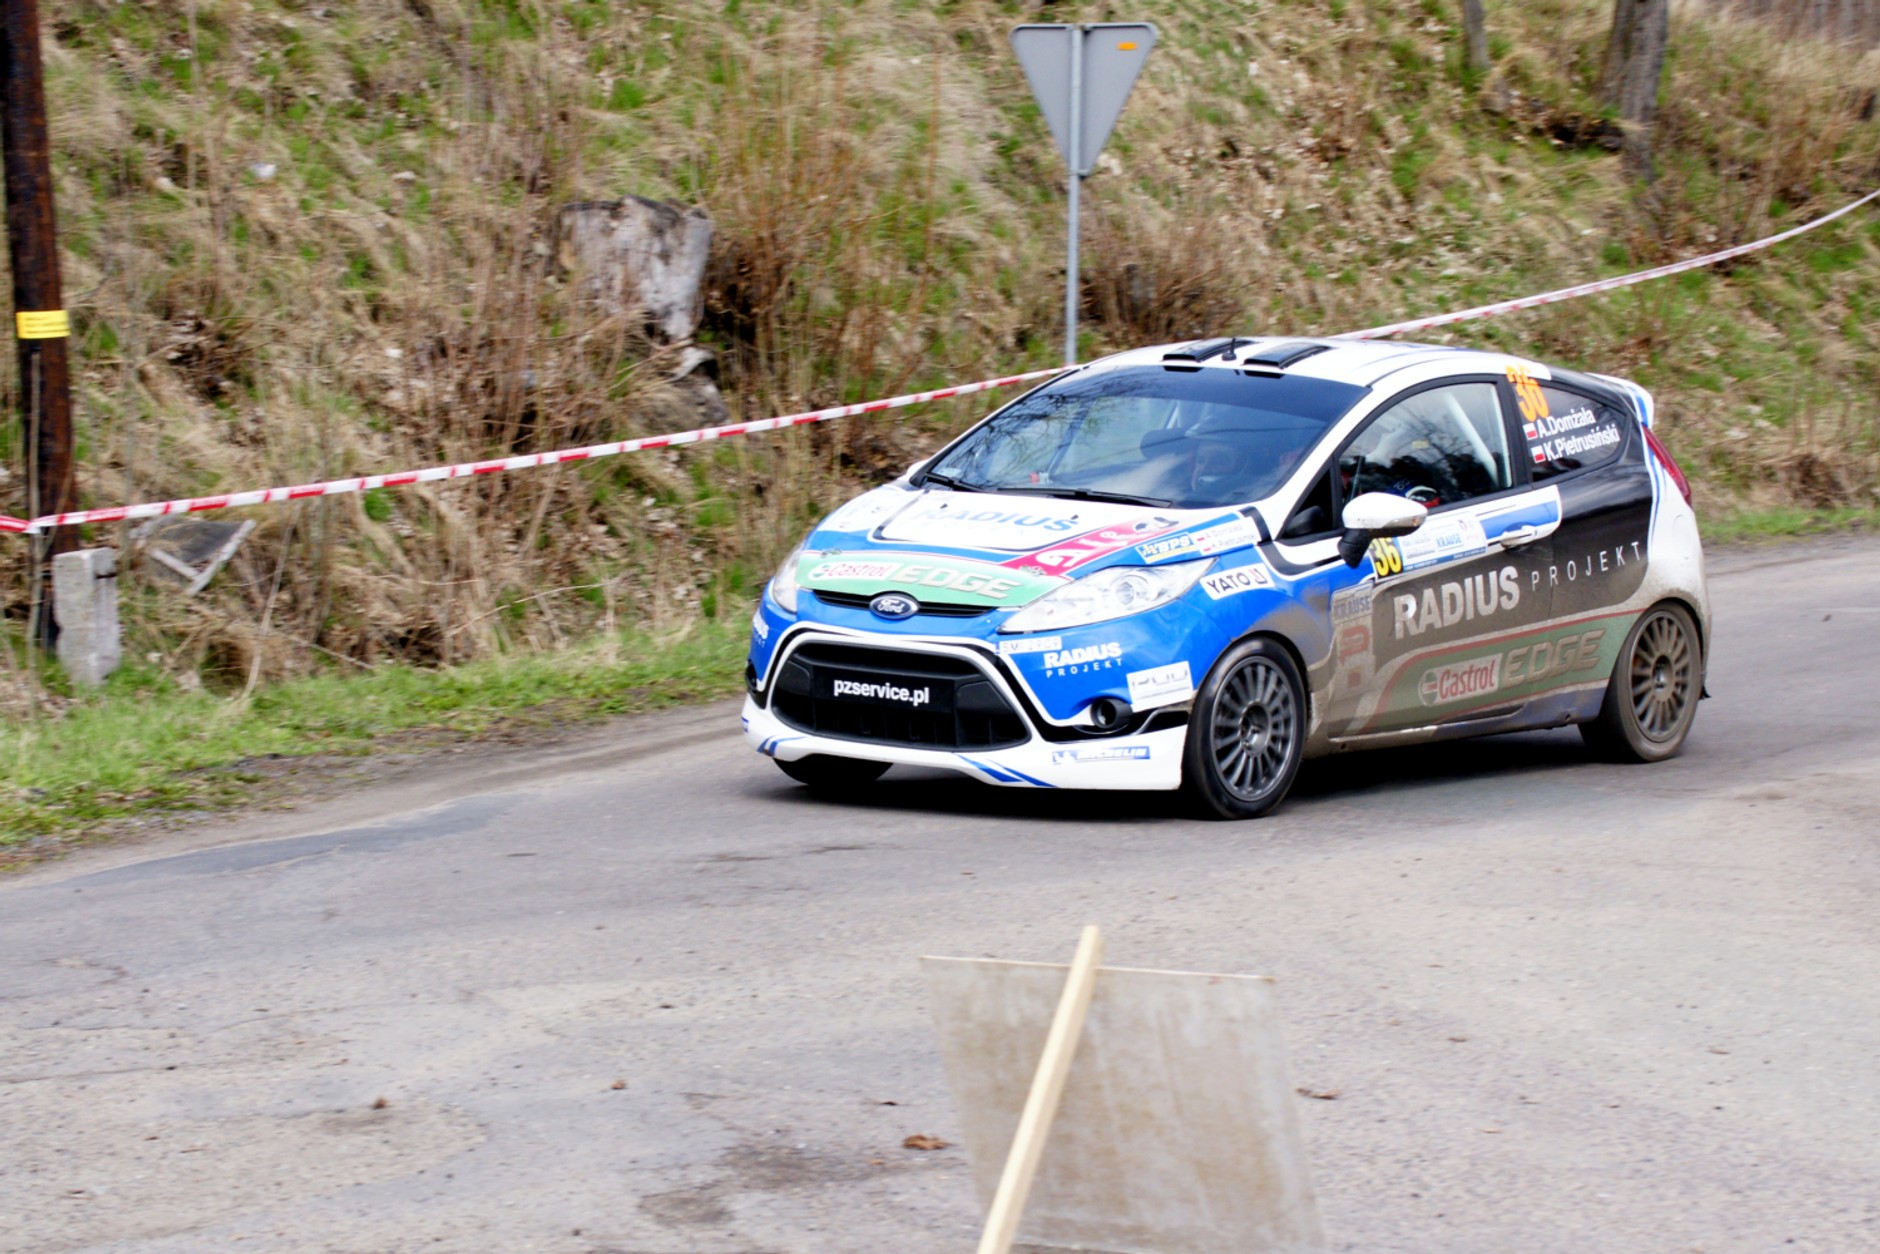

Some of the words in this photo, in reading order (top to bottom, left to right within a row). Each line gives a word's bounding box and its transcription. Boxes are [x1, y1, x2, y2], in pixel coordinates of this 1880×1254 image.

[1505, 364, 1549, 422] 36
[1544, 424, 1620, 461] K.Pietrusiński
[911, 508, 1079, 532] RADIUS
[1369, 537, 1402, 577] 36
[828, 563, 895, 577] Castrol
[890, 564, 1022, 601] EDGE
[1207, 572, 1251, 593] YATO
[1394, 565, 1520, 640] RADIUS
[1531, 541, 1641, 592] PROJEKT
[877, 599, 905, 613] Ford
[1333, 596, 1371, 621] KRAUSE
[1044, 642, 1123, 669] RADIUS
[1046, 659, 1123, 679] PROJEKT
[1439, 658, 1496, 699] Castrol
[1502, 628, 1606, 688] EDGE
[833, 679, 930, 706] pzservice.pl
